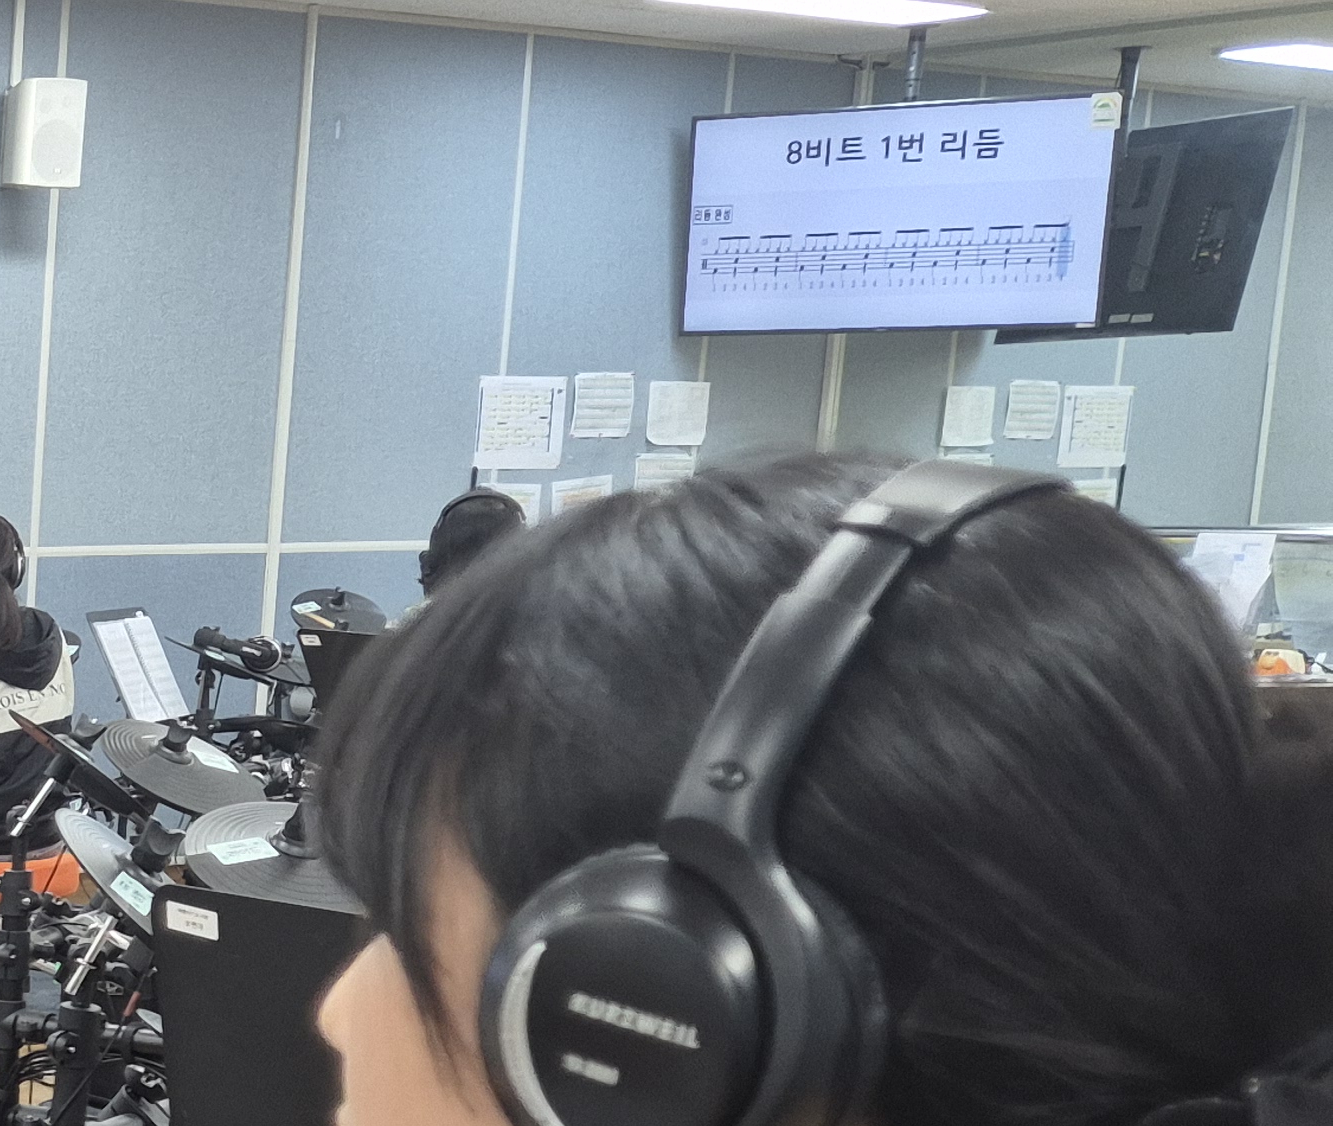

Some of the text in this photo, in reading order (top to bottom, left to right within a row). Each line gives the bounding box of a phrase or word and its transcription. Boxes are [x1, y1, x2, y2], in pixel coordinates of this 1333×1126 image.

[786, 127, 1005, 167] 8비트 1번 리듬
